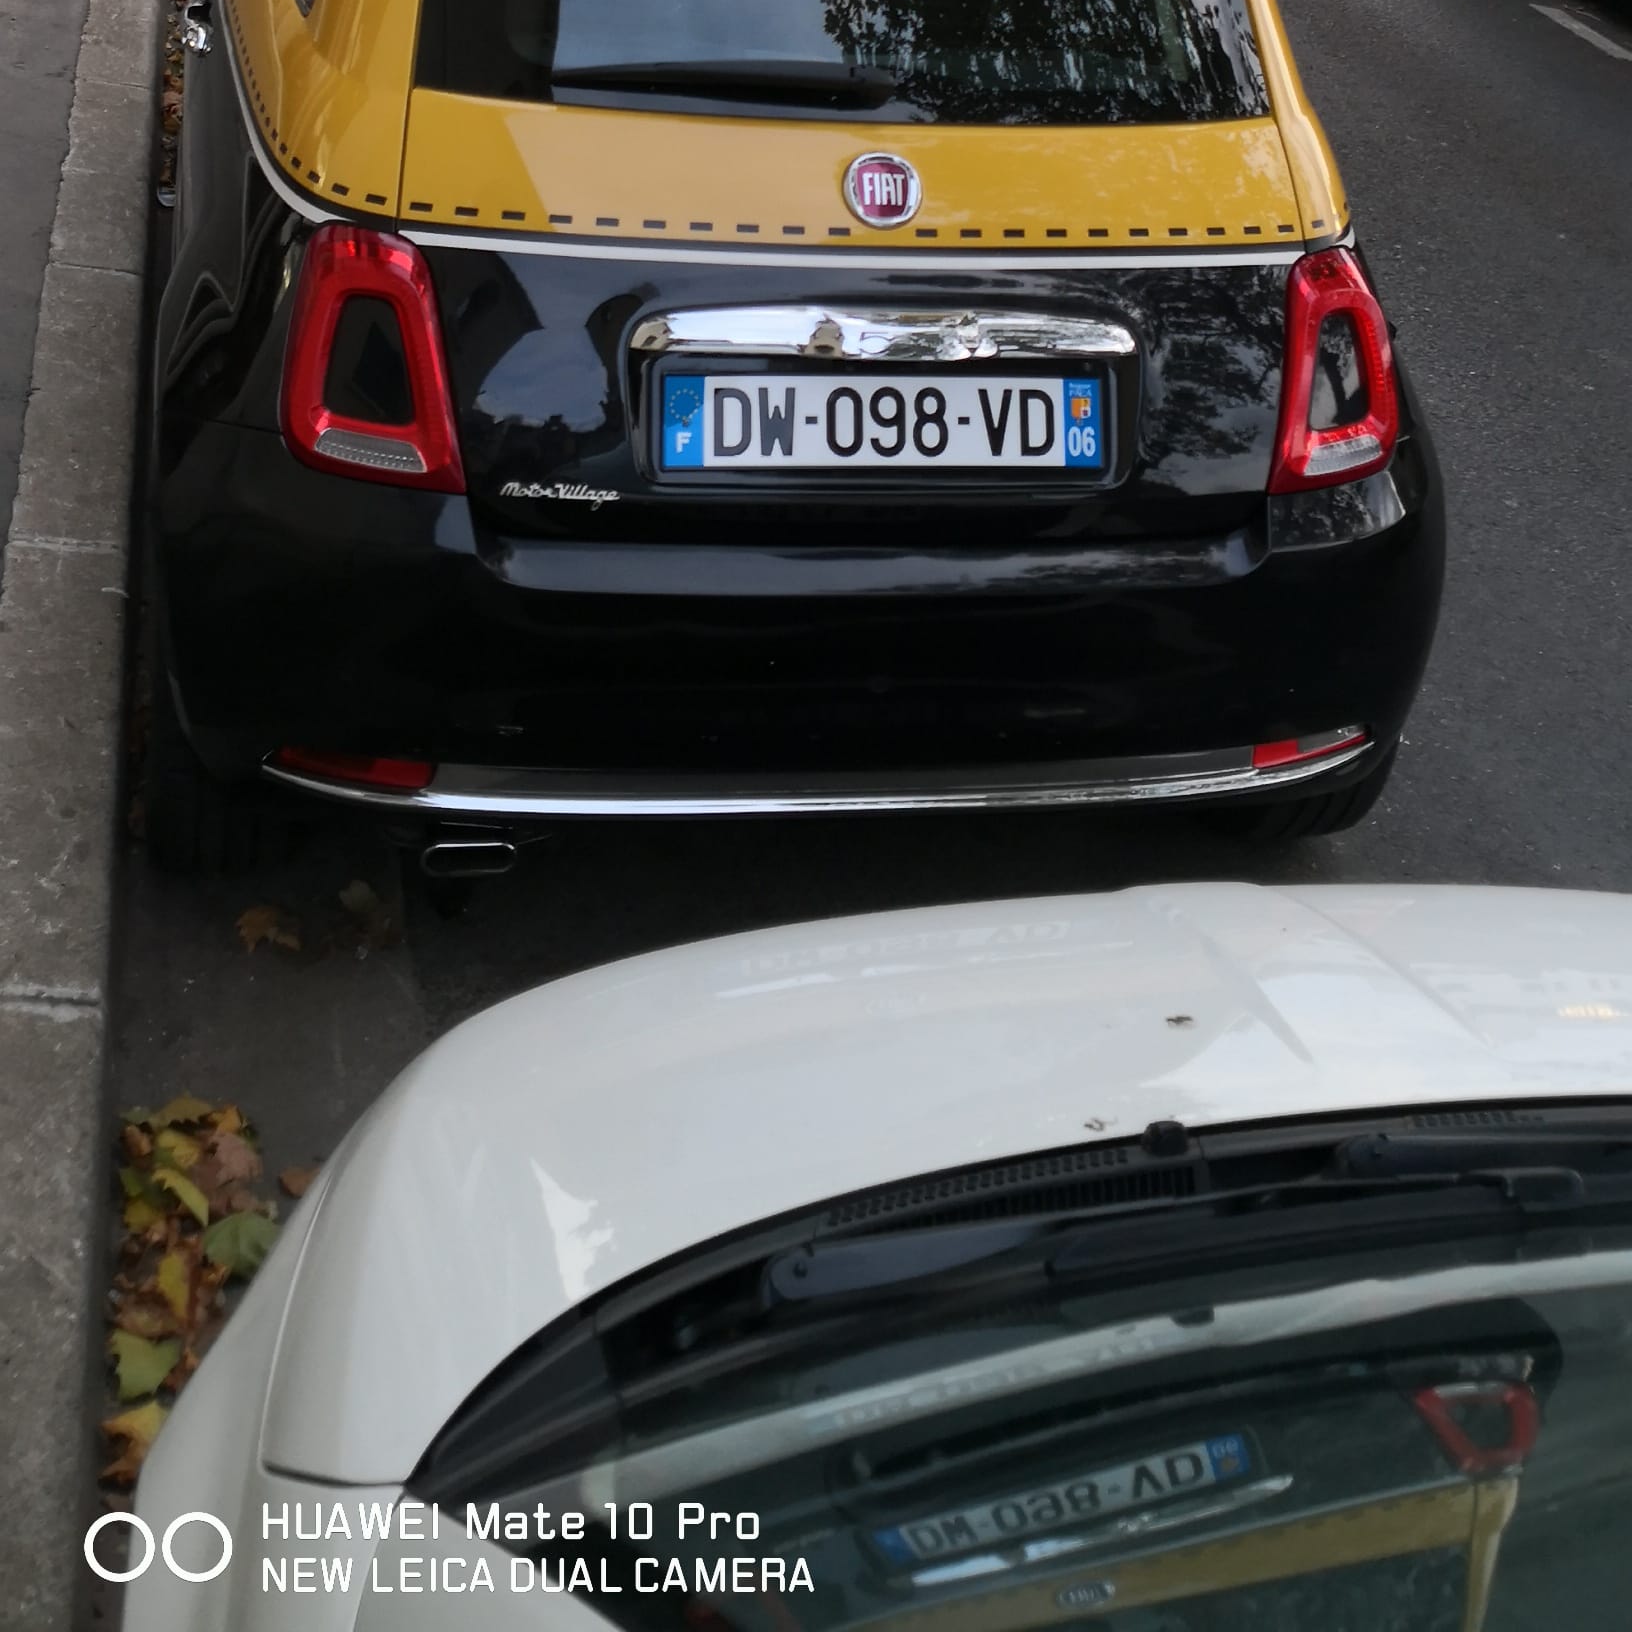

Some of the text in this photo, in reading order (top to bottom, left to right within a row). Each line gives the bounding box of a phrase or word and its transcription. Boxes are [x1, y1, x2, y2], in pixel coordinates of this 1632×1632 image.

[862, 172, 905, 206] FIAT
[714, 386, 1055, 457] DW-098-VD
[675, 432, 692, 454] F
[1067, 426, 1096, 457] 06
